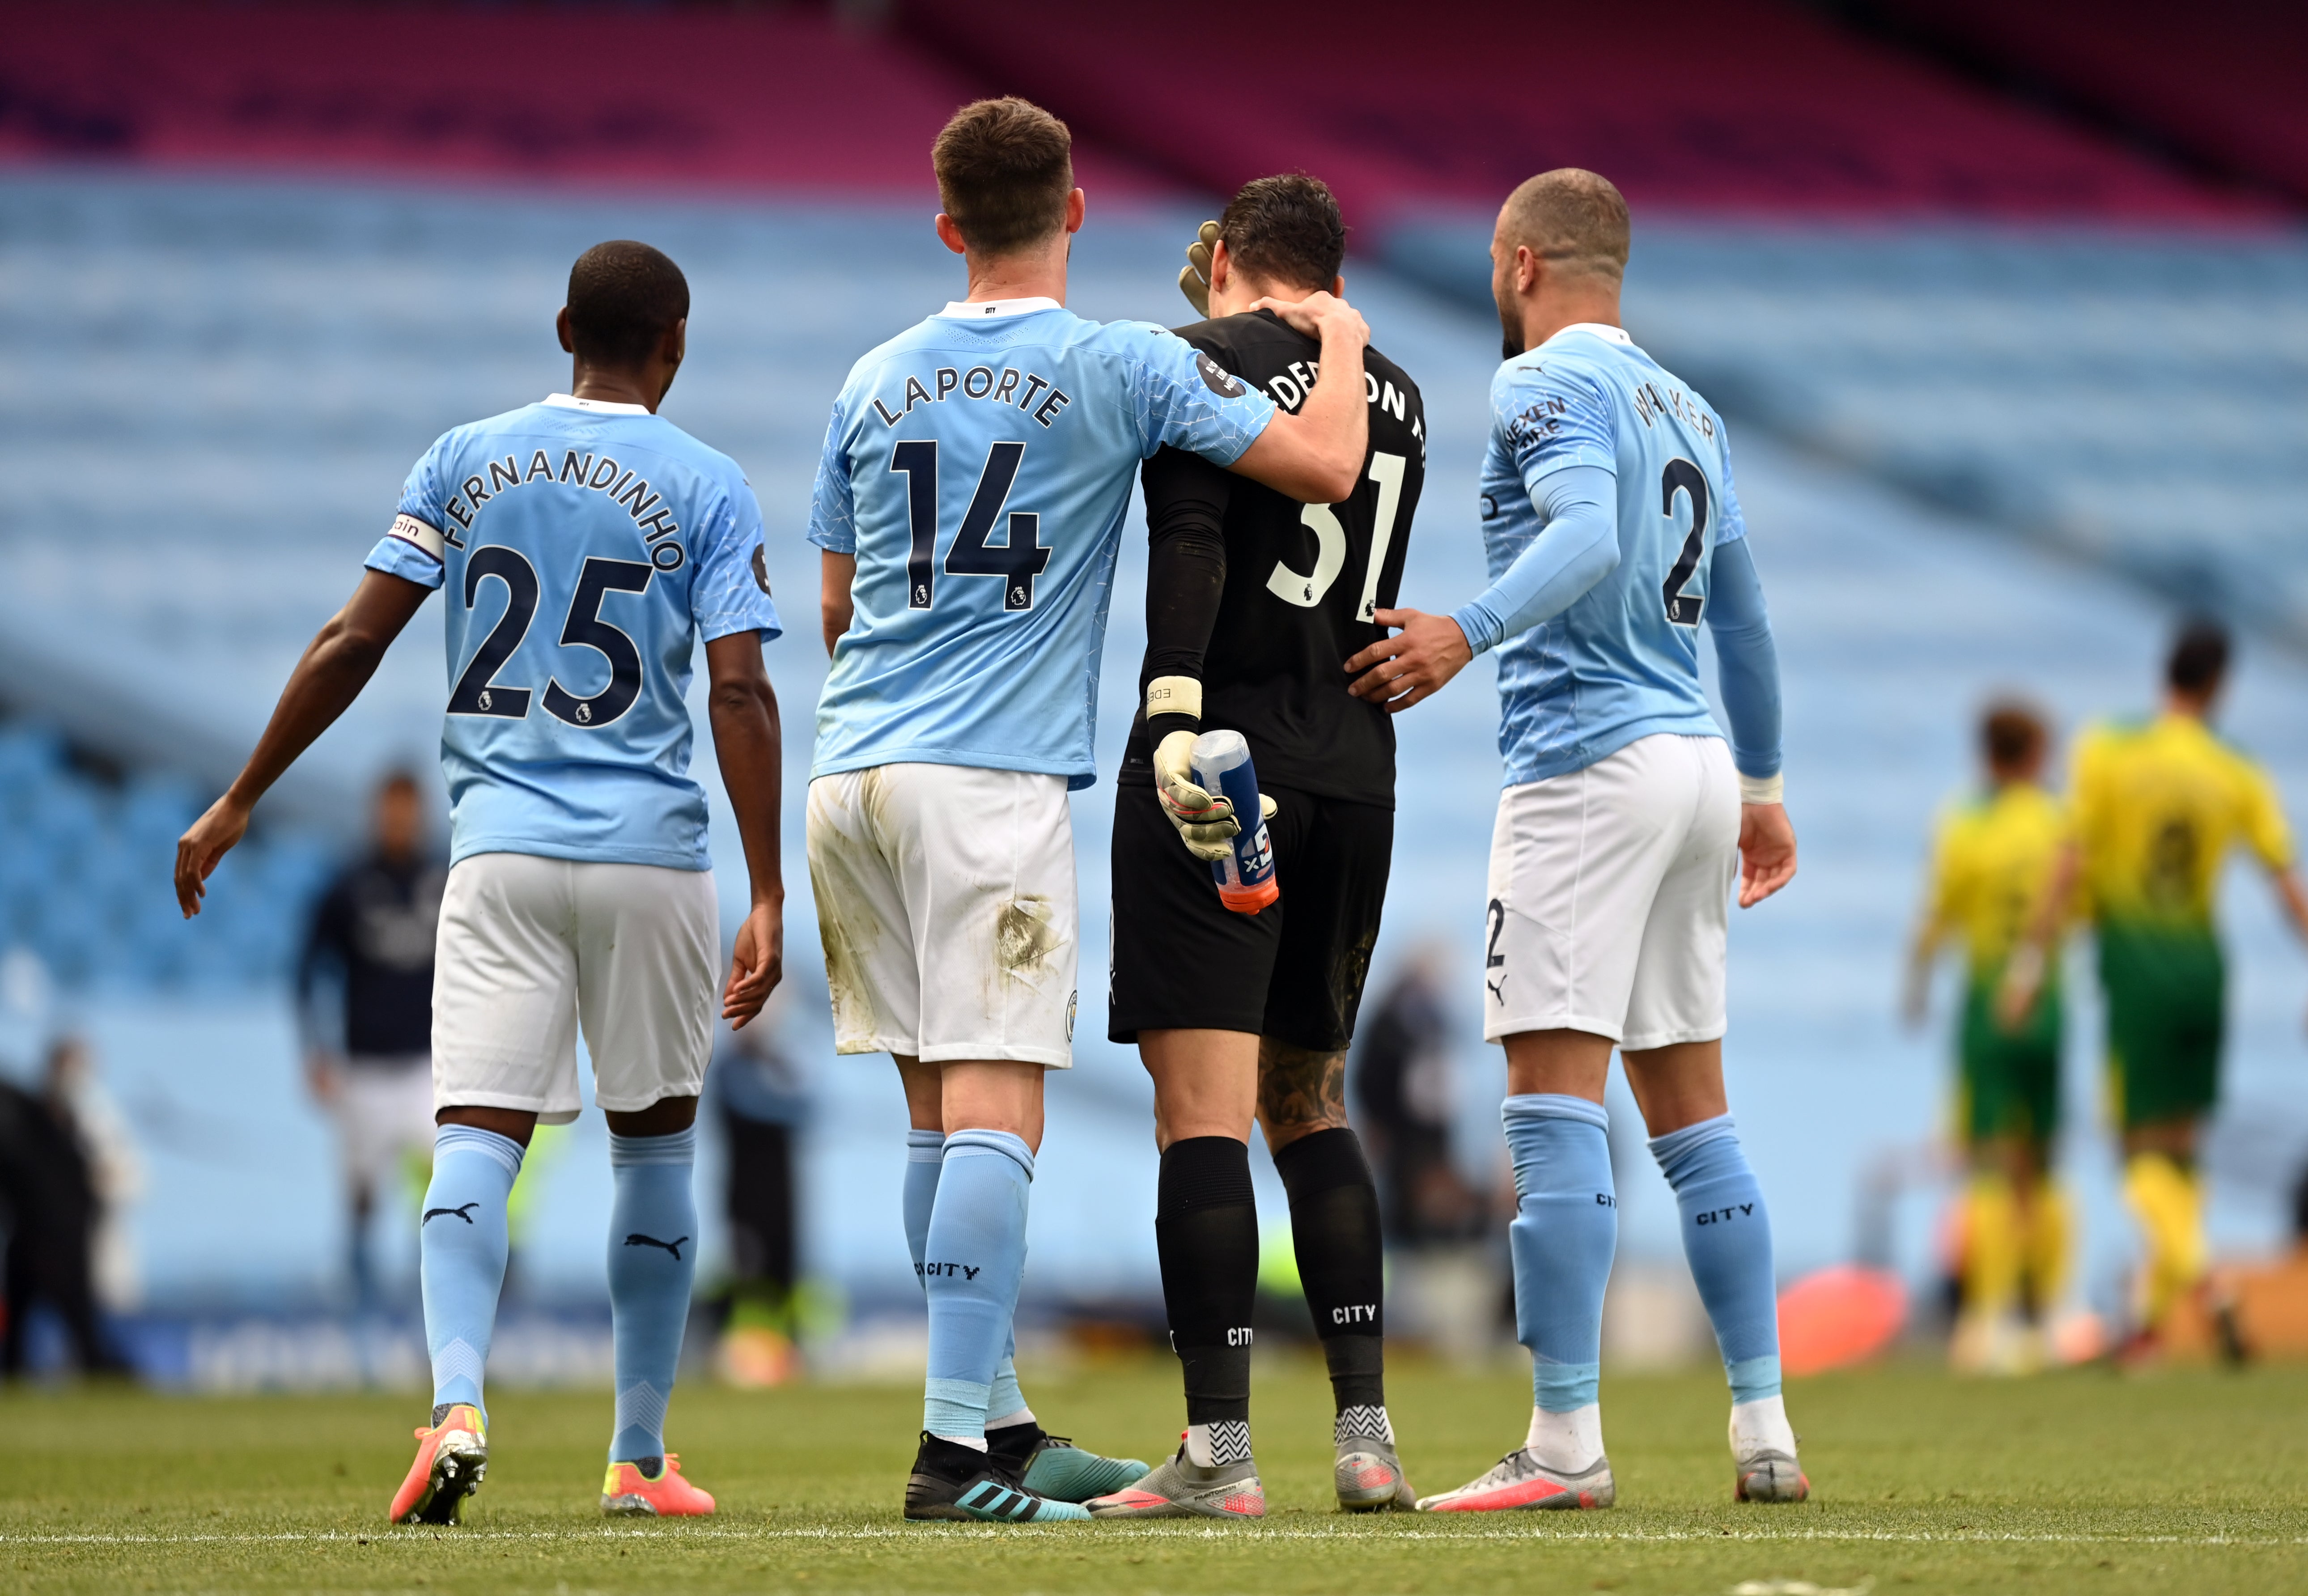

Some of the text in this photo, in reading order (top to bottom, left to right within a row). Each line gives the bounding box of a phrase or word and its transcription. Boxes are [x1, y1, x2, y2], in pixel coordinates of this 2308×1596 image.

[873, 366, 1071, 429] LAPORTE
[1633, 381, 1714, 447] WAKER
[1519, 418, 1564, 449] TIRE
[444, 449, 686, 573] FERNANDINHO
[889, 439, 1053, 611] 14
[1662, 456, 1710, 628] 2
[446, 544, 655, 730] 25
[1486, 898, 1506, 969] 2
[1696, 1203, 1754, 1226] CITY
[927, 1262, 980, 1280] CITY
[1332, 1304, 1376, 1324] CITY
